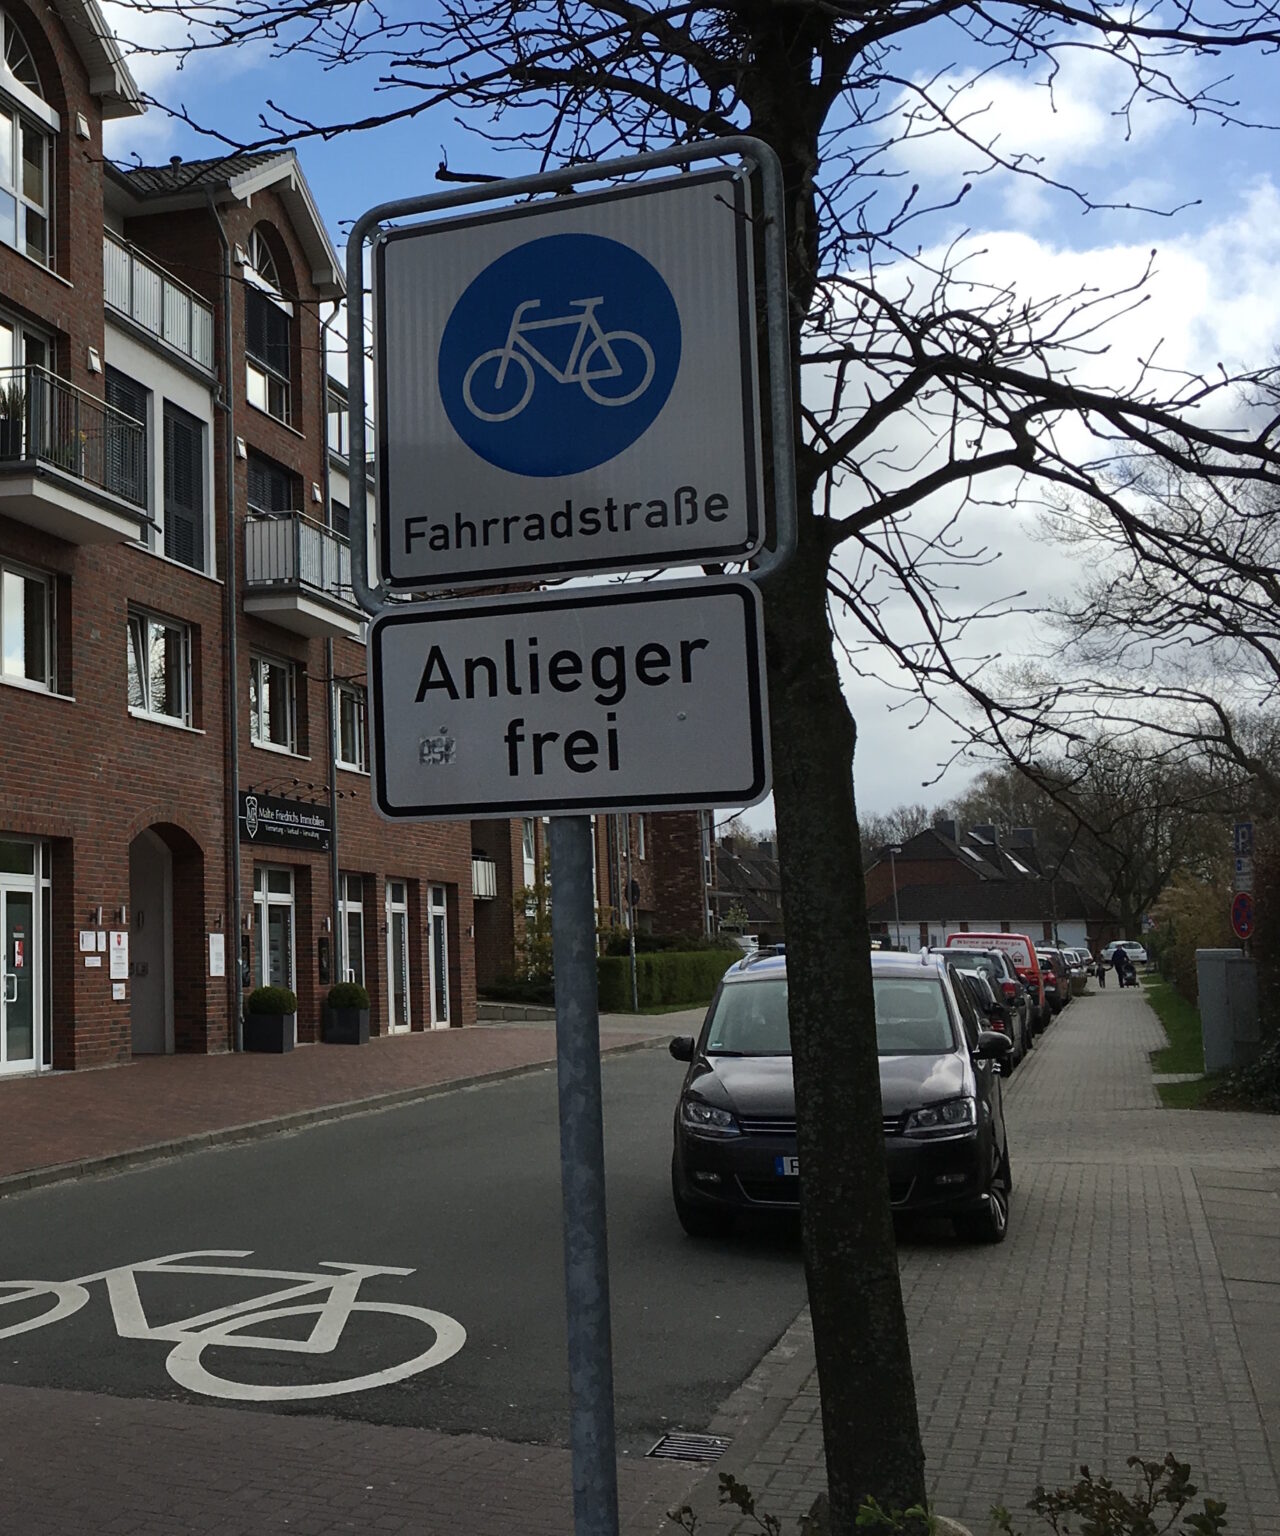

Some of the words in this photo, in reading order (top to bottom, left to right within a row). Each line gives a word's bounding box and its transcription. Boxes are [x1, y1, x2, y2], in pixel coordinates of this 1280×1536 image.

[404, 486, 729, 554] Fahrradstraße
[414, 637, 710, 705] Anlieger
[504, 712, 620, 777] frei
[258, 808, 274, 819] Malte
[275, 809, 299, 823] Friedrichs
[300, 813, 325, 827] Immobilien
